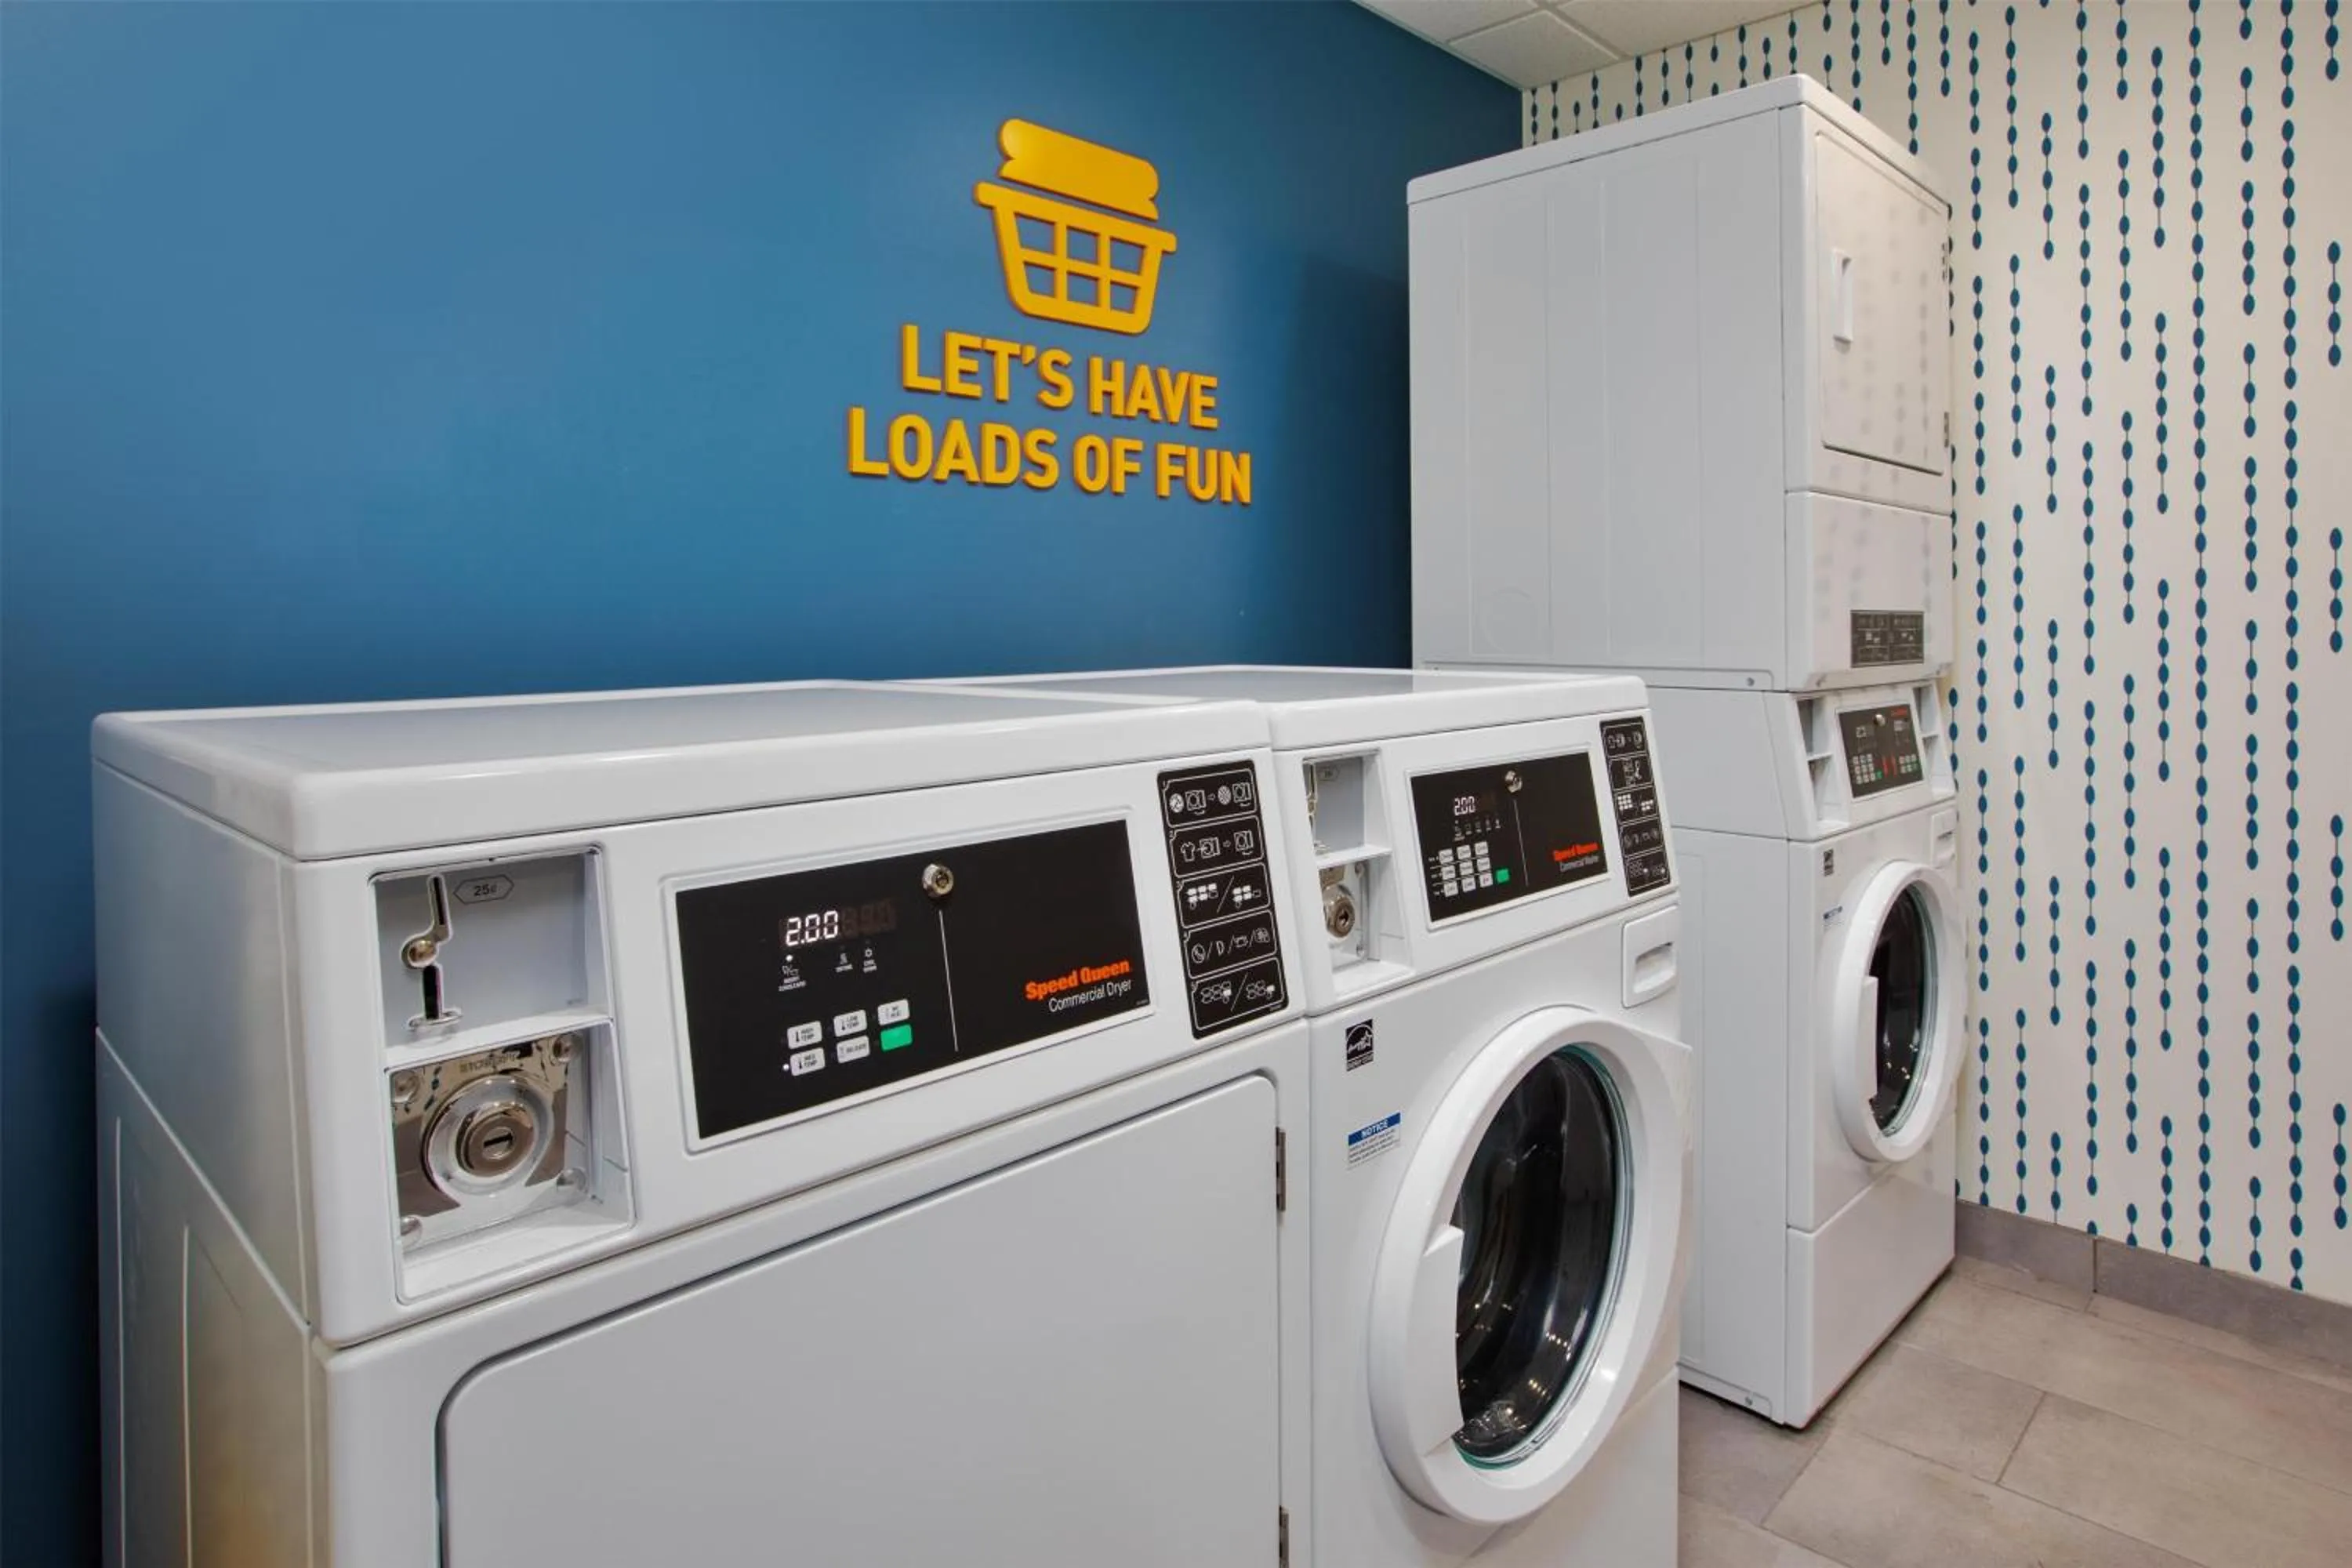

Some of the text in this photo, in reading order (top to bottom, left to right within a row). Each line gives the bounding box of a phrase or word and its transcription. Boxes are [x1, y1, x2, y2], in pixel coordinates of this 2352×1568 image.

[902, 324, 1218, 429] LET'S HAVE
[848, 406, 1251, 504] LOADS OF FUN
[786, 910, 838, 946] 2.00
[1025, 960, 1131, 1000] Speed Queen
[1048, 980, 1131, 1012] Commercial Dryer
[1361, 1120, 1388, 1138] NOTICE
